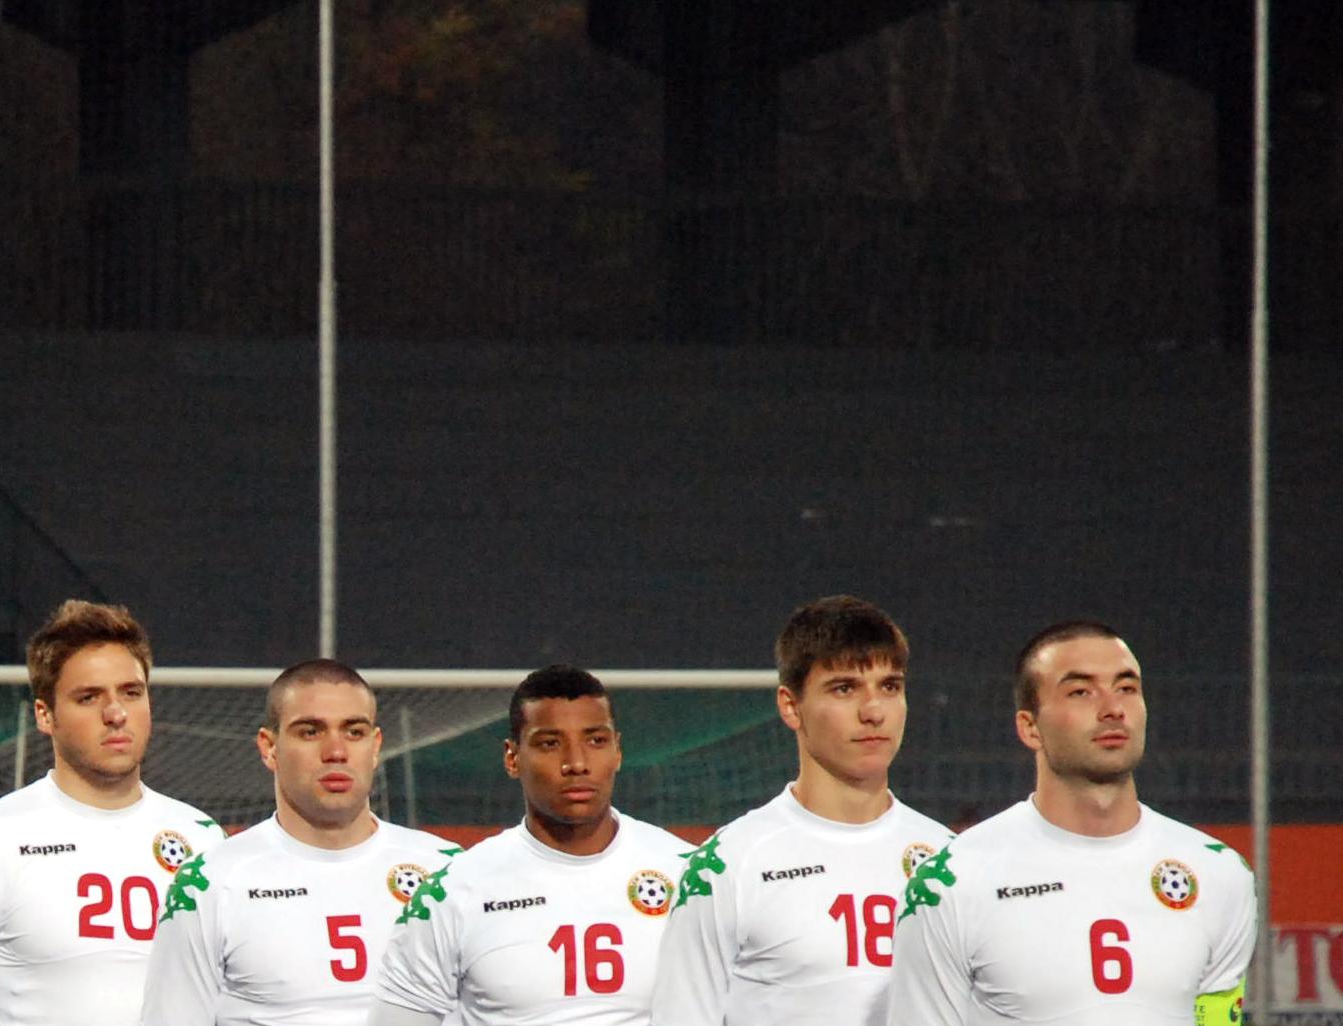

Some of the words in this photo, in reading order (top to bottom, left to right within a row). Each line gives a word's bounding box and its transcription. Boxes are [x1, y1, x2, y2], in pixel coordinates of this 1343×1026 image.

[19, 843, 77, 857] Kappa
[248, 887, 309, 900] Kappa
[760, 864, 826, 883] Kappa
[995, 881, 1064, 900] Kappa
[78, 873, 159, 941] 20
[483, 896, 547, 914] Kappa
[327, 915, 367, 982] 5
[829, 894, 897, 967] 18
[549, 924, 624, 996] 16
[1090, 919, 1133, 994] 6
